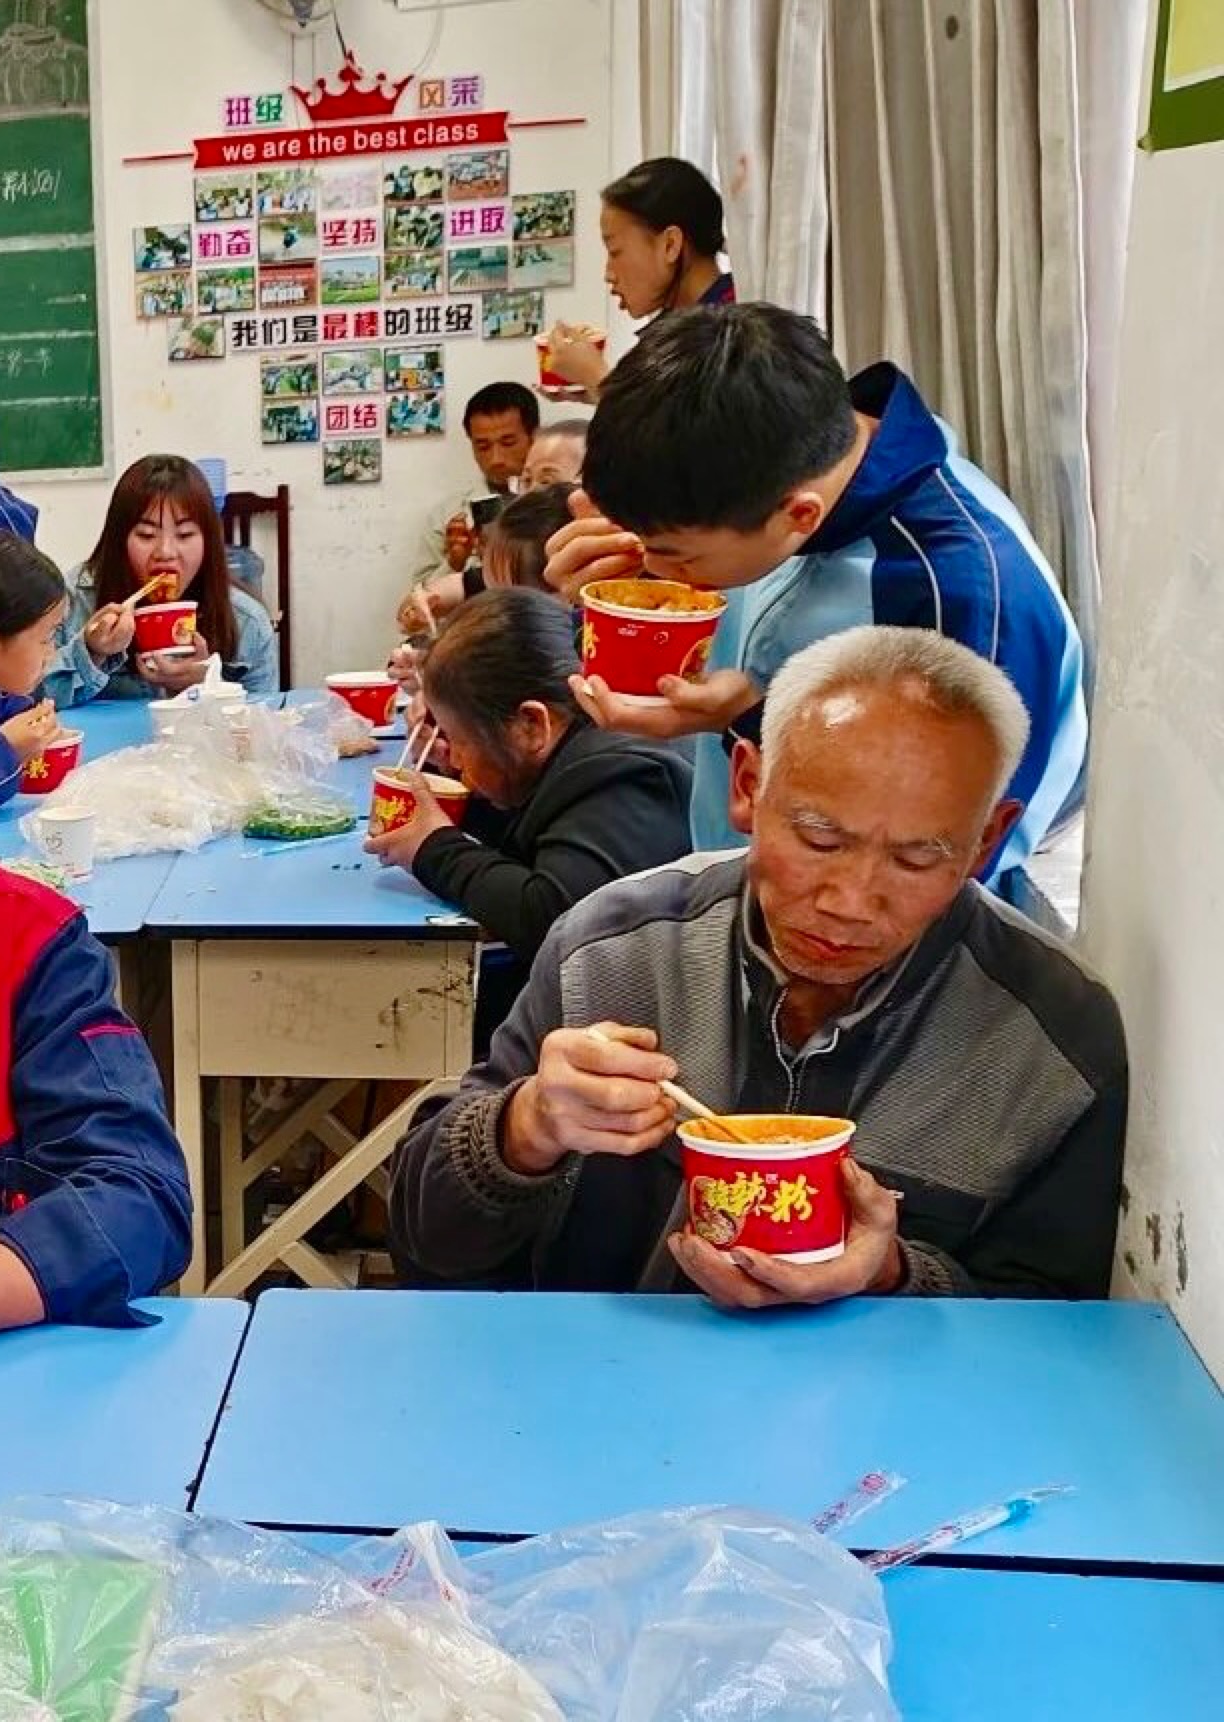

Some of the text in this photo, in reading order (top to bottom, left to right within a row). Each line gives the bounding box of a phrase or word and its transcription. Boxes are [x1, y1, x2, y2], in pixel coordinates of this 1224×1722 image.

[225, 75, 479, 126] 班级 风采
[222, 121, 479, 162] we are the best class
[323, 218, 376, 247] 坚持
[450, 206, 505, 236] 进取
[197, 229, 251, 258] 勤奋
[231, 303, 473, 347] 我们是最棒的班级
[326, 403, 378, 430] 团结
